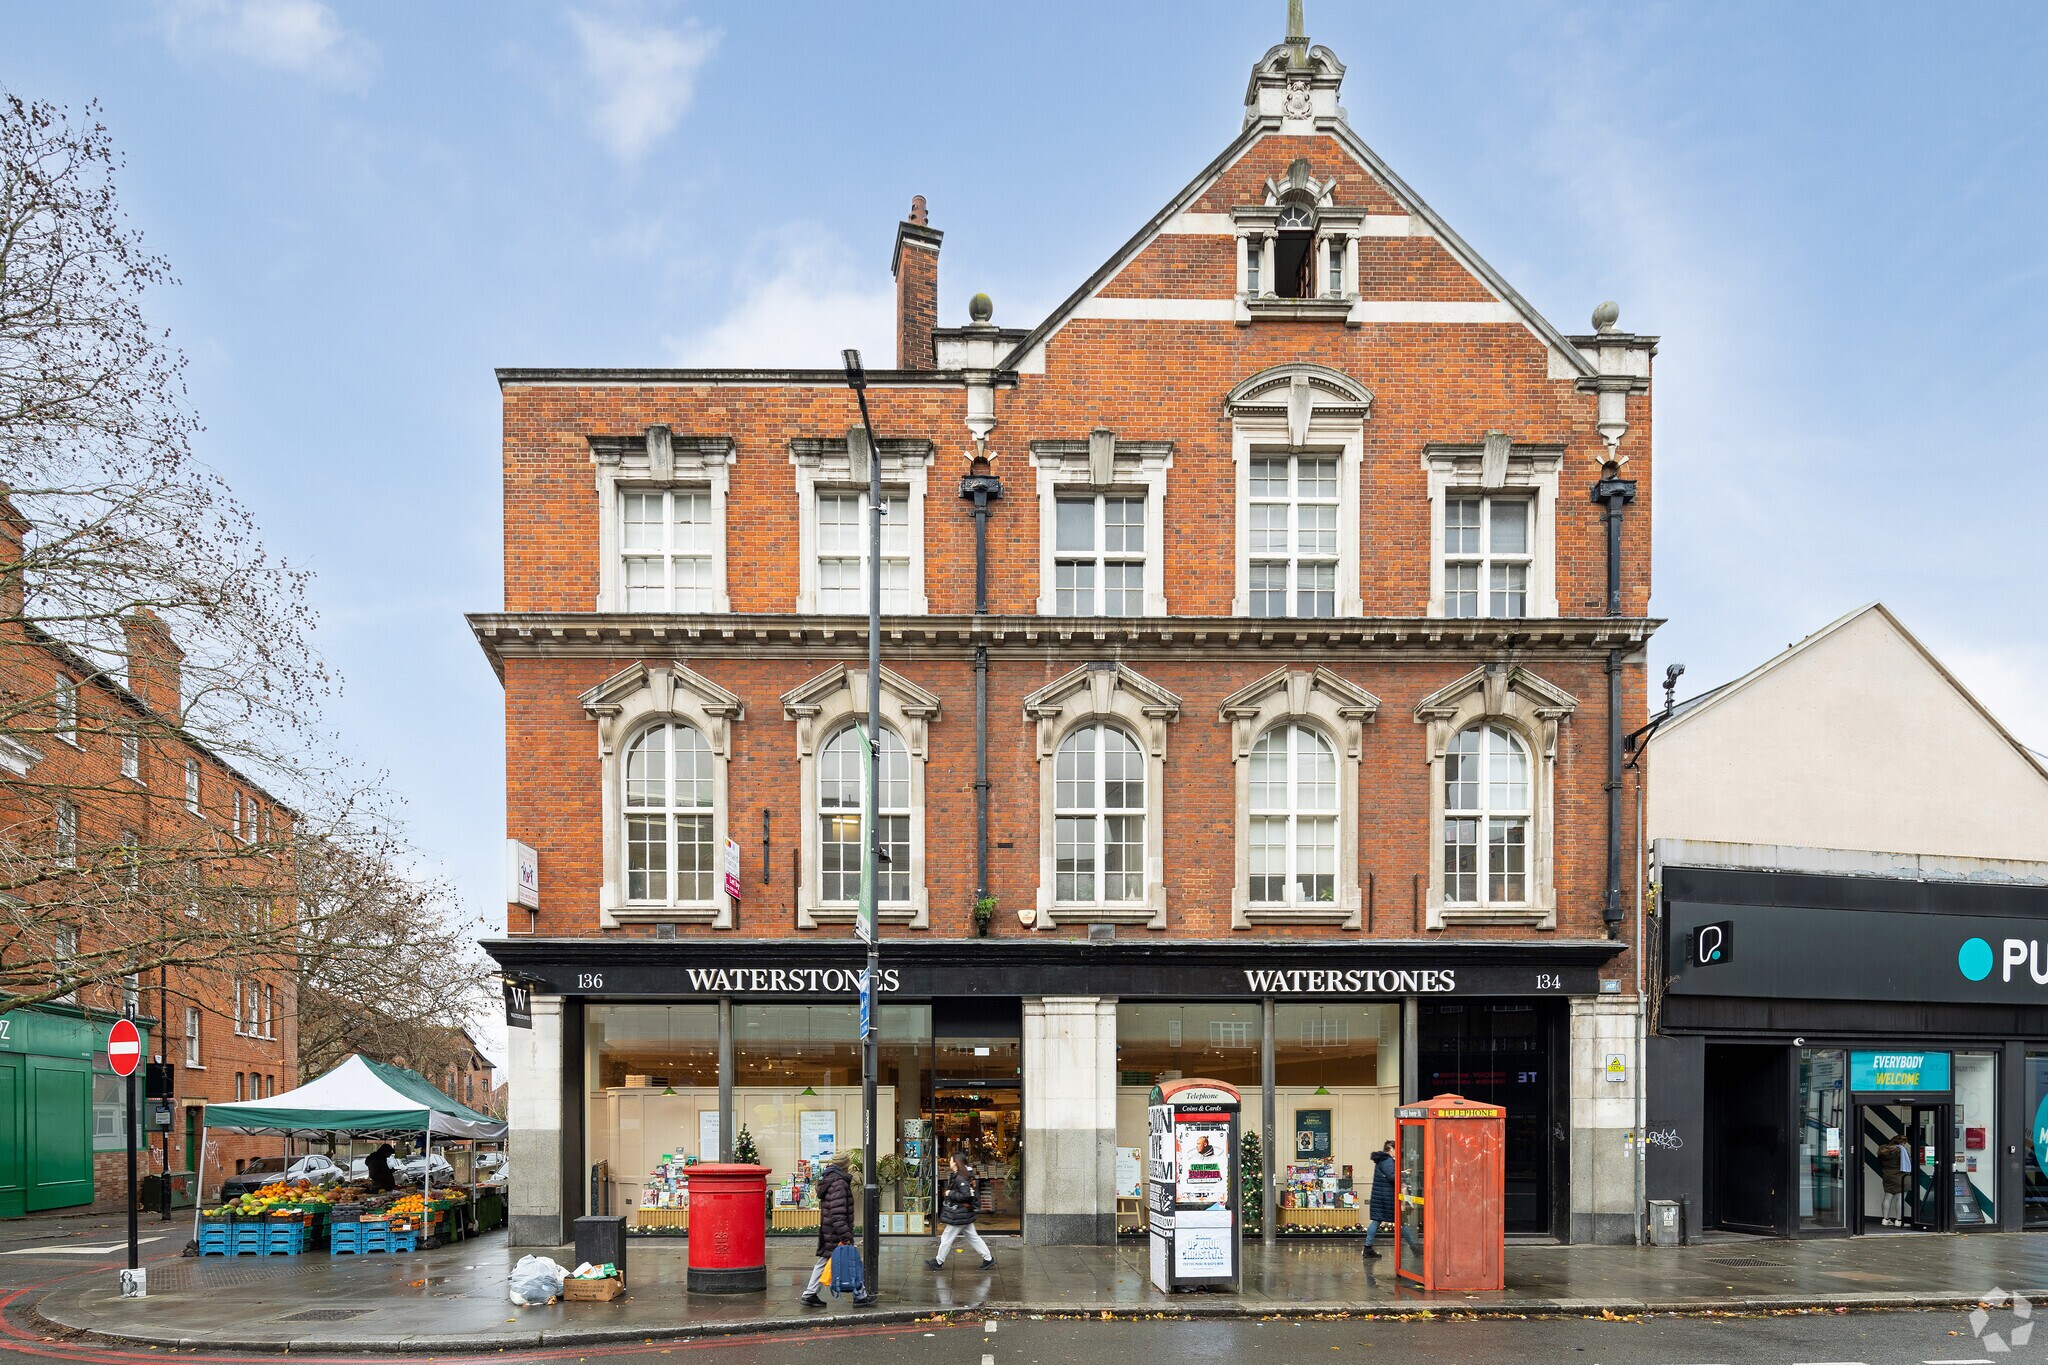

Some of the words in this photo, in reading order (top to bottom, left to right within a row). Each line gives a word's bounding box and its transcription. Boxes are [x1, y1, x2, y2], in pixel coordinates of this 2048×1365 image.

[2003, 938, 2048, 985] PU
[577, 973, 603, 989] 136
[1244, 969, 1455, 992] WATERSTONES
[1535, 974, 1561, 989] 134
[510, 986, 527, 1011] W
[1872, 1055, 1925, 1069] EVERYBODY
[1875, 1072, 1920, 1086] WELCOME
[1186, 1092, 1219, 1101] Telephone
[1442, 1109, 1494, 1118] TELEPHONE
[1187, 1239, 1198, 1250] UP
[1181, 1249, 1226, 1260] CHRISTMAS
